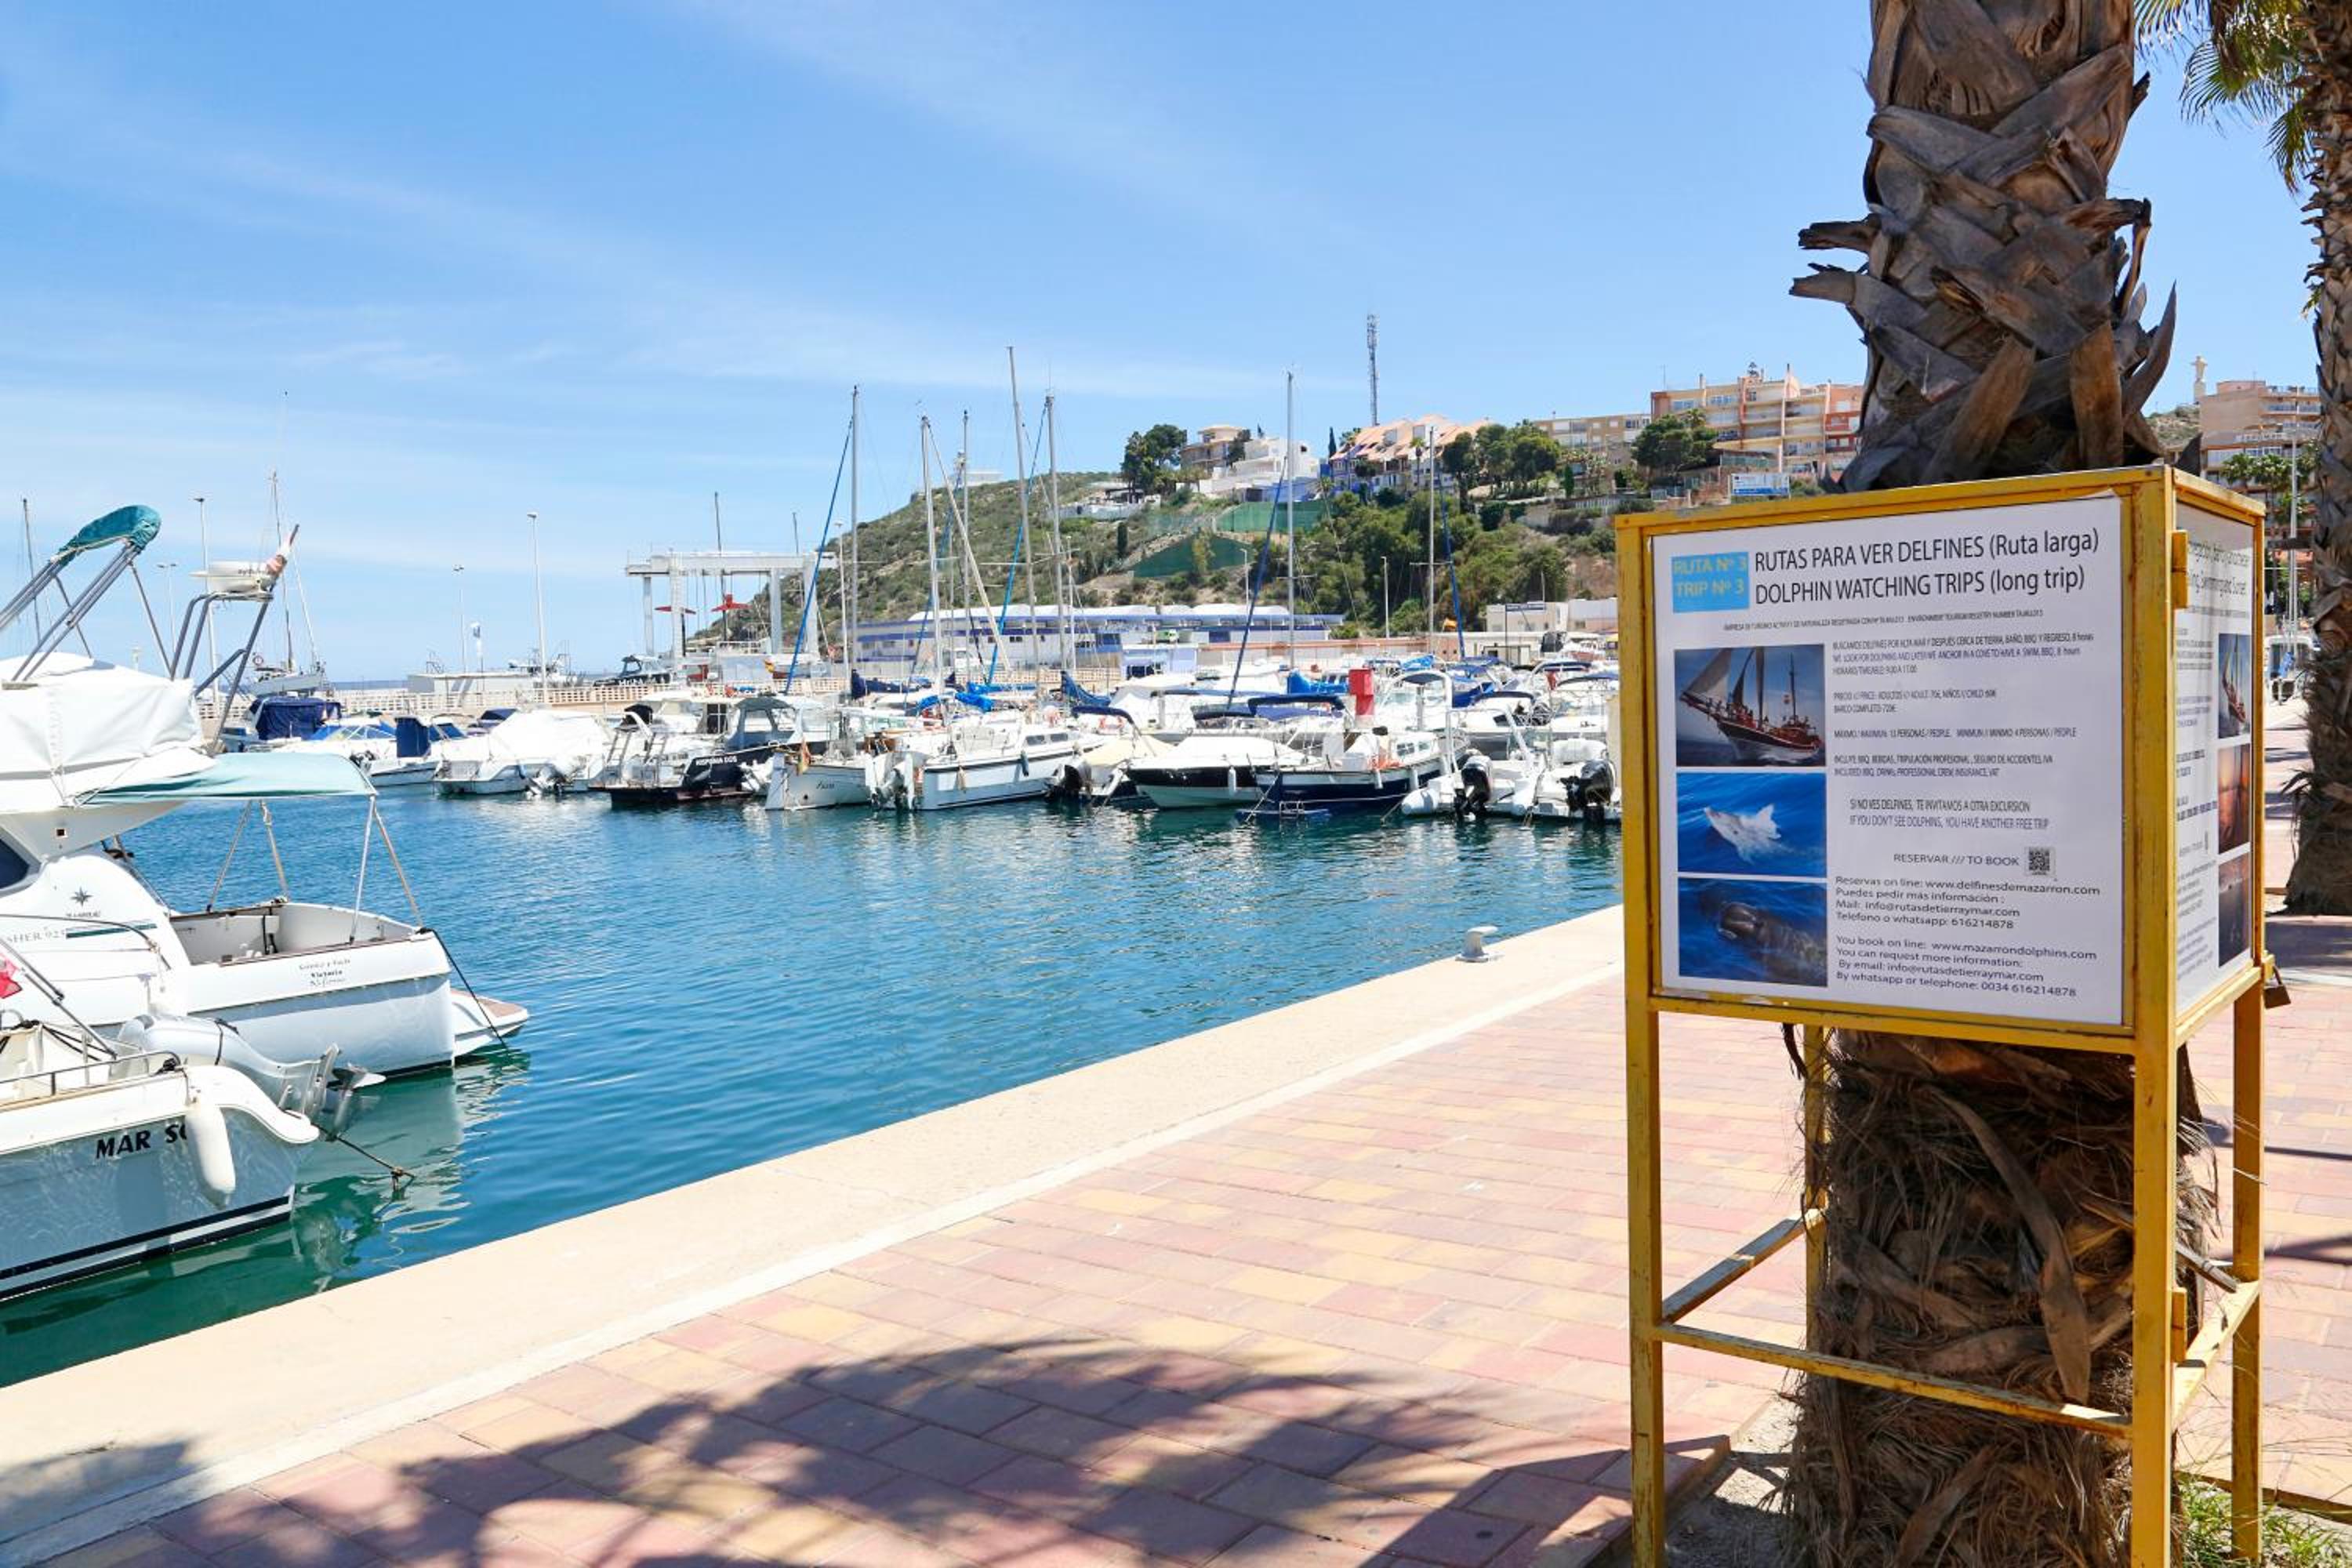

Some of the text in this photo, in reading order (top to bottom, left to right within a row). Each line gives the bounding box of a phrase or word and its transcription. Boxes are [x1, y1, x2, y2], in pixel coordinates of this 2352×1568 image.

[1755, 527, 2099, 574] RUTAS PARA VER DELFINES (Ruta larga)
[1674, 557, 1715, 575] RUTA
[1738, 554, 1748, 572] 3
[1676, 582, 1708, 598] TRIP
[1736, 577, 1745, 596] 3
[1755, 564, 2085, 604] DOLPHIN WATCHING TRIPS (long trip)
[1937, 650, 1962, 659] ANCHOR
[1857, 798, 1869, 810] NO
[1916, 798, 1925, 811] TE
[1925, 799, 1962, 811] INVITAMOS
[1963, 800, 1969, 811] A
[1970, 800, 1989, 811] OTRA
[1849, 815, 1857, 826] IF
[1857, 815, 1871, 826] YOU
[1893, 815, 1906, 827] SEE
[1945, 816, 1961, 828] YOU
[1961, 817, 1980, 829] HAVE
[1981, 817, 2015, 829] ANOTHER
[2015, 817, 2033, 829] FREE
[2033, 818, 2049, 829] TRIP
[1893, 853, 1949, 864] RESERVAR
[1966, 855, 1983, 866] TO
[1984, 855, 2020, 867] BOOK
[1835, 875, 1882, 886] Reservas
[1883, 878, 1898, 887] on
[1924, 880, 2101, 897] www.delfinesdemazarron.com
[1835, 887, 1874, 898] Puedes
[1876, 889, 1904, 900] pedir
[1865, 901, 2021, 917] info@rutasdetierraymar.com
[1951, 918, 2015, 929] 616214878
[1836, 935, 1856, 946] You
[1857, 937, 1884, 946] book
[1931, 942, 2098, 960] www.mazarrondolphins.com
[1836, 948, 1856, 957] You
[1878, 950, 1920, 961] request
[1921, 953, 1951, 964] more
[1838, 959, 2045, 982] By email: info@rutasdetierraymar.com
[1835, 970, 1849, 982] By
[1851, 972, 1903, 985] whatsapp
[1919, 977, 1979, 990] telephone:
[1980, 982, 2009, 993] 0034
[2011, 984, 2078, 997] 616214878
[96, 1130, 152, 1160] MAR
